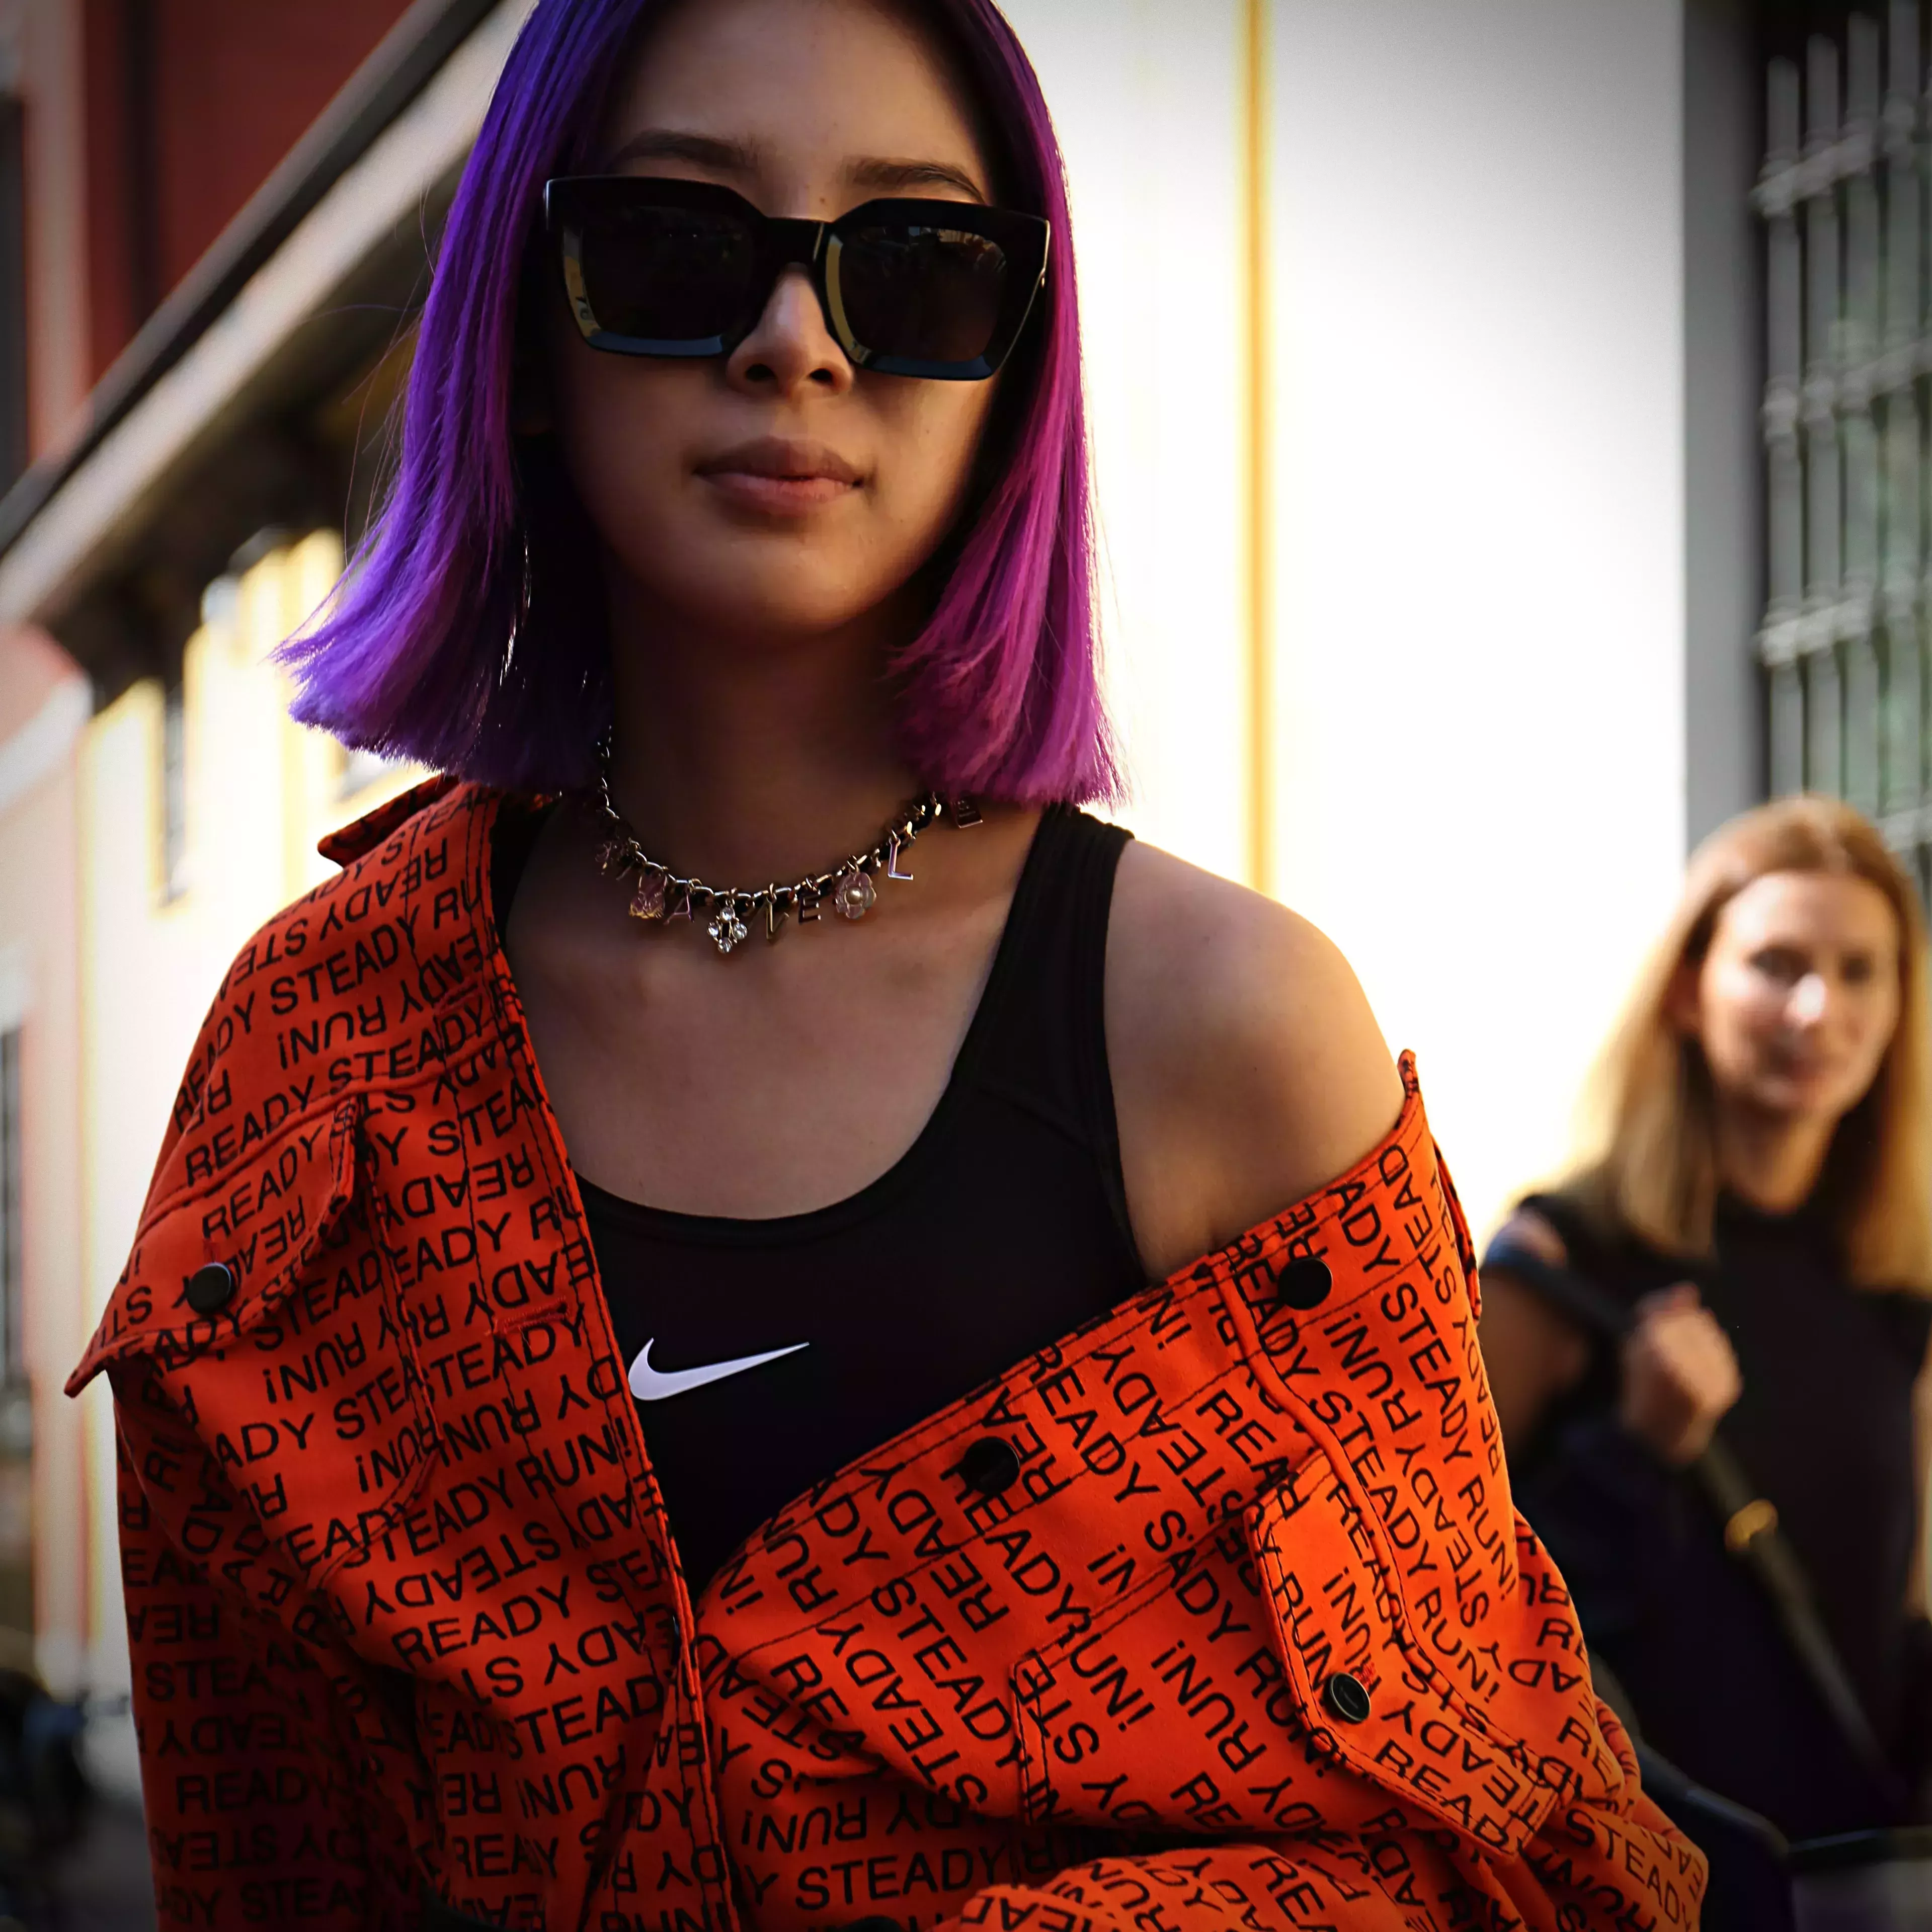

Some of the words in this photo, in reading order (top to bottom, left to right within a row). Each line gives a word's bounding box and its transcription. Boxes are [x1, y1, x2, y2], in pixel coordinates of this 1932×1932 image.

[320, 837, 447, 941] READY
[174, 991, 255, 1133] READY
[269, 903, 421, 1016] STEADY
[276, 994, 387, 1070] RUN!
[185, 1075, 314, 1187] READY
[329, 997, 485, 1096] STEADY
[202, 1124, 324, 1239] READY
[384, 1143, 536, 1231] READY
[263, 1322, 366, 1403] RUN!
[1029, 1342, 1161, 1503] READY
[1323, 1313, 1422, 1433] RUN!
[516, 1418, 632, 1499] RUN!
[1381, 1281, 1472, 1465] STEADY
[1458, 1474, 1516, 1600] RUN!
[365, 1521, 561, 1625] STEADY
[859, 1463, 1009, 1633] READY
[1310, 1391, 1438, 1576] STEADY
[1415, 1586, 1500, 1704] RUN!
[1396, 1444, 1489, 1628] STEADY
[392, 1575, 570, 1671] READY
[871, 1578, 1033, 1768] STEADY
[1058, 1608, 1155, 1732] RUN!
[816, 1624, 987, 1805] STEADY
[1151, 1640, 1267, 1773] RUN!
[514, 1744, 626, 1820] RUN!
[742, 1797, 866, 1854] RUN!
[796, 1843, 1005, 1910] STEADY
